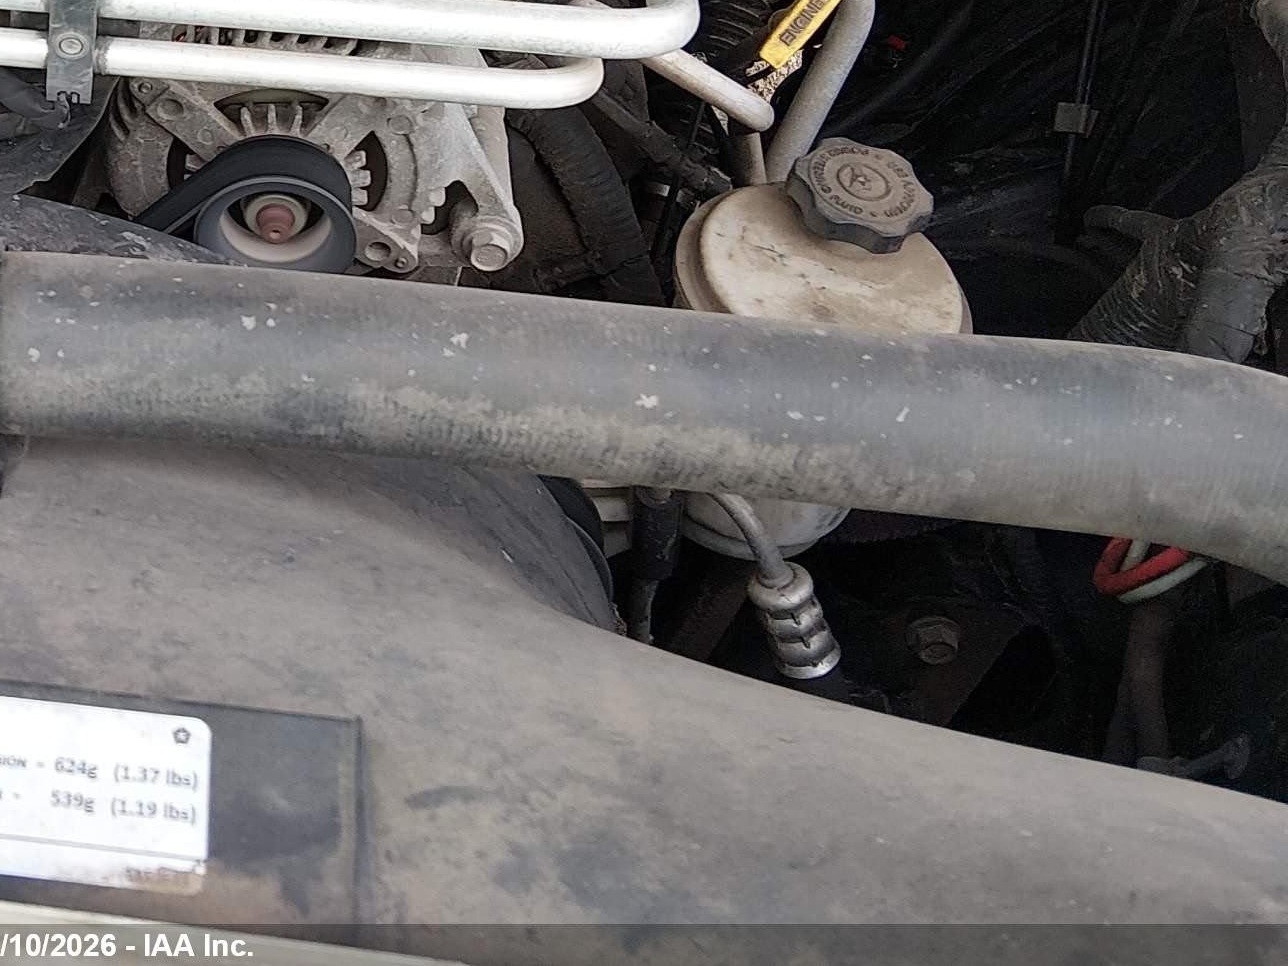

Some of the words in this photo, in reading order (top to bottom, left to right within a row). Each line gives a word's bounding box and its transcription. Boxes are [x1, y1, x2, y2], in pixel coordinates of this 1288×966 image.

[830, 195, 864, 215] FLUID
[54, 756, 99, 780] 624g
[113, 763, 161, 784] (1.37
[165, 769, 199, 792] lbs)
[50, 789, 96, 814] 539g
[110, 797, 158, 818] (1.19
[163, 802, 197, 826] lbs)
